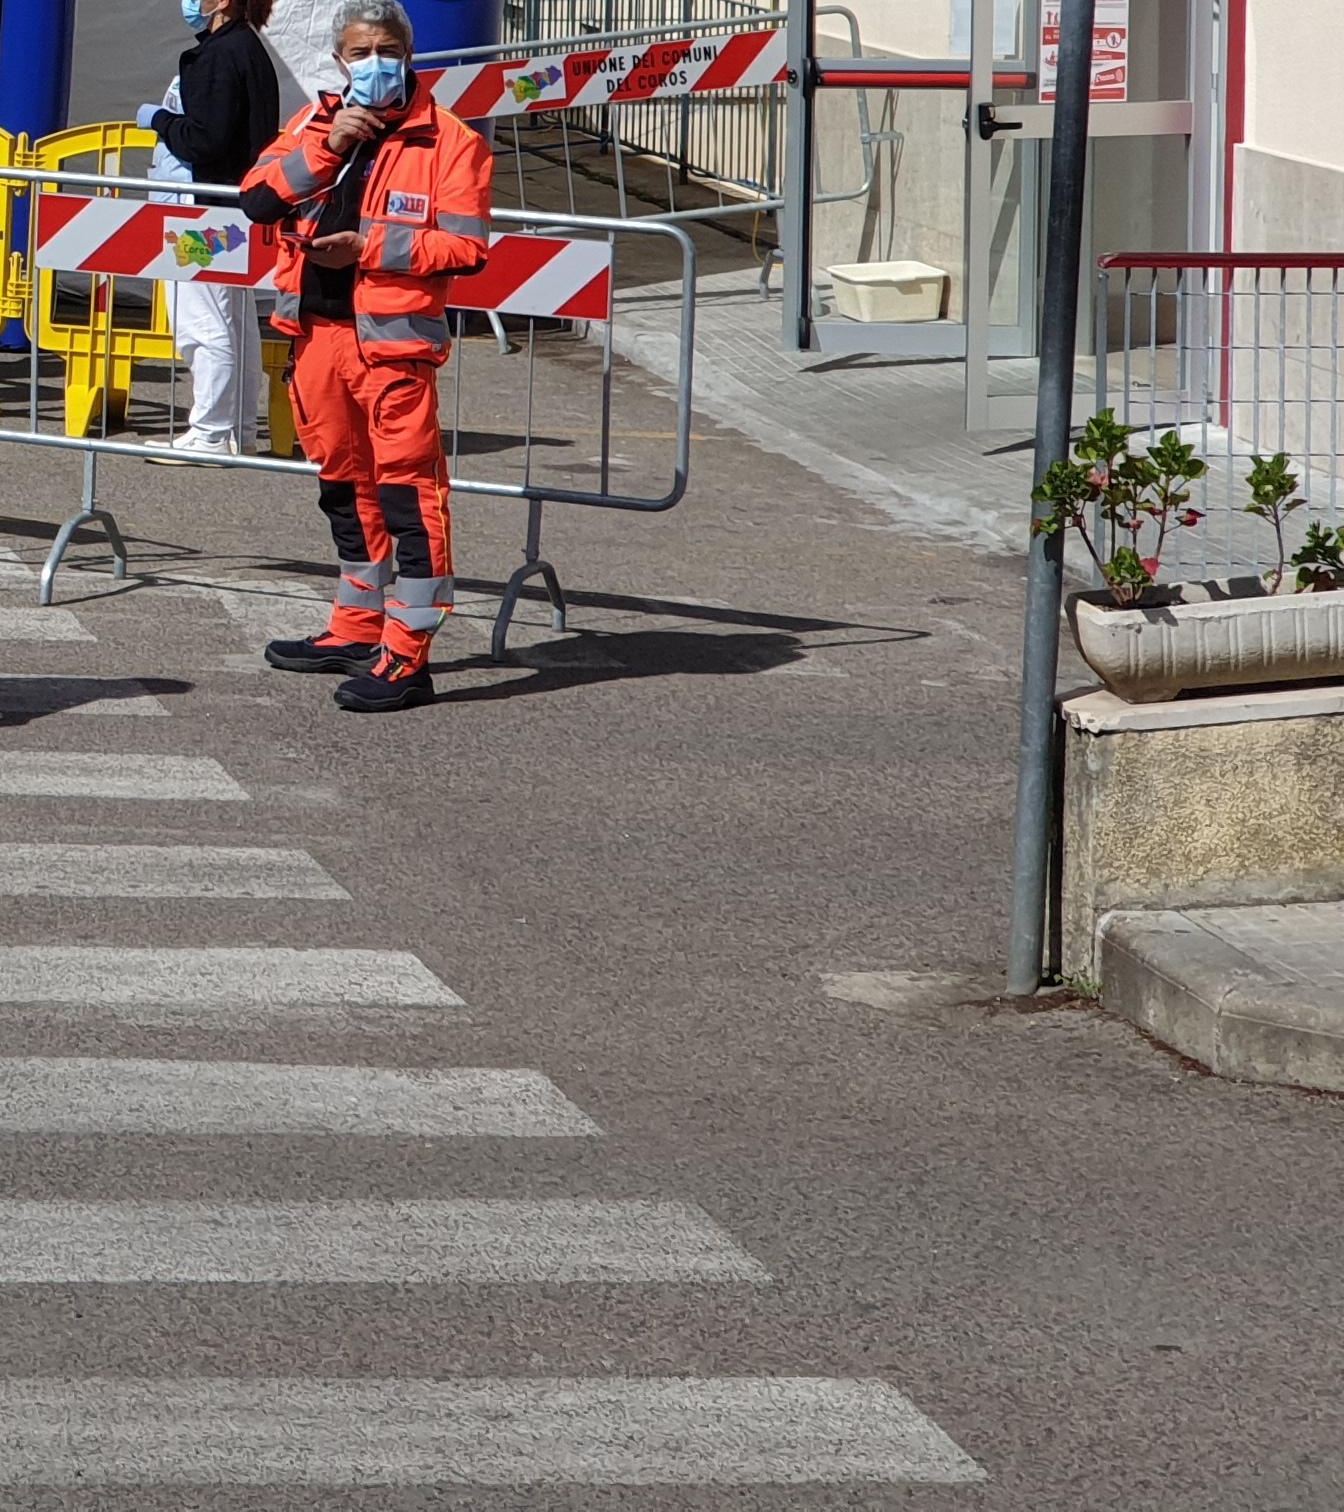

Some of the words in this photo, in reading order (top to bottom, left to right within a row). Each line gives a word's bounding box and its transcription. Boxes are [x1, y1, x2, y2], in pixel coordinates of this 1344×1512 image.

[572, 55, 626, 77] UNIONE
[631, 51, 656, 70] DEI
[661, 45, 718, 66] COMUNI
[606, 76, 632, 94] DEL
[637, 70, 688, 91] COROS
